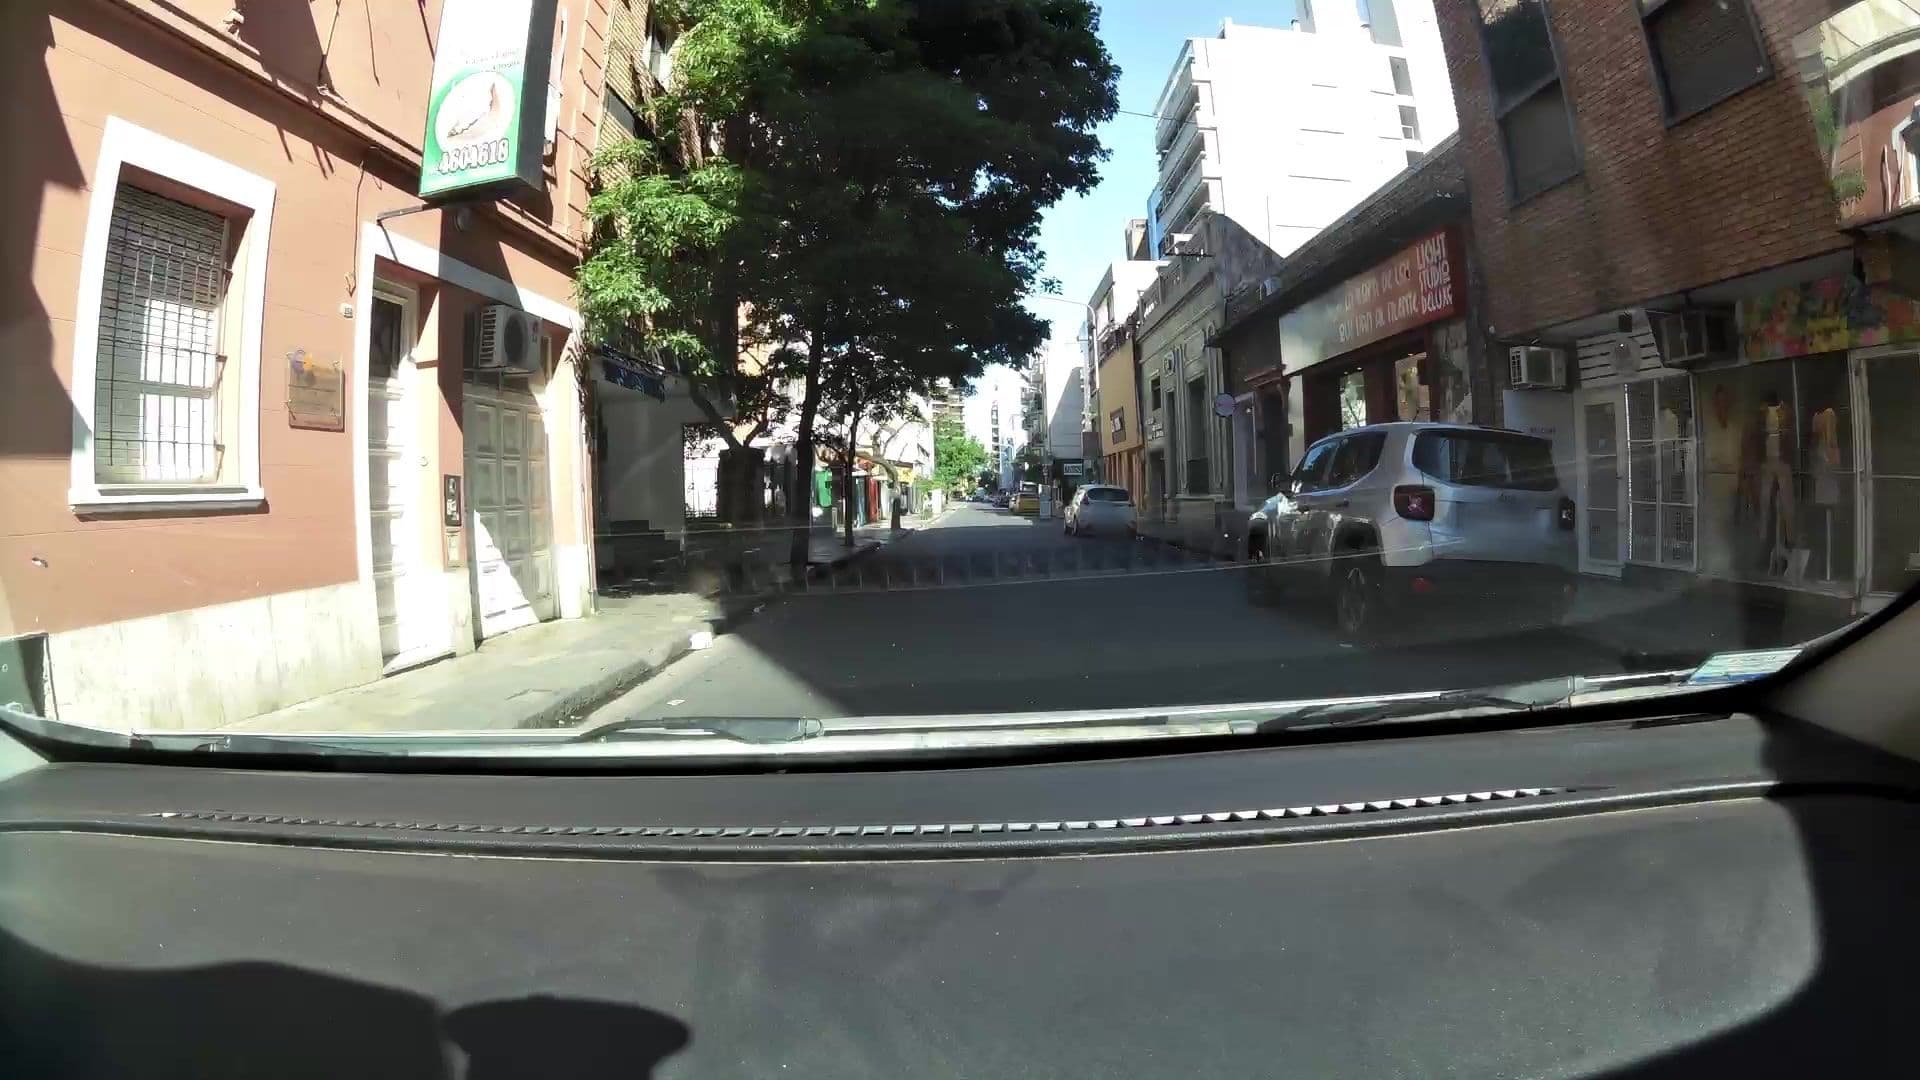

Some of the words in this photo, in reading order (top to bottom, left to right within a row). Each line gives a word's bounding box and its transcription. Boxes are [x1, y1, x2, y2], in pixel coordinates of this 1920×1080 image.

[438, 138, 510, 175] 4604618
[1416, 231, 1446, 270] LIGHT
[1419, 260, 1451, 298] STUDIO
